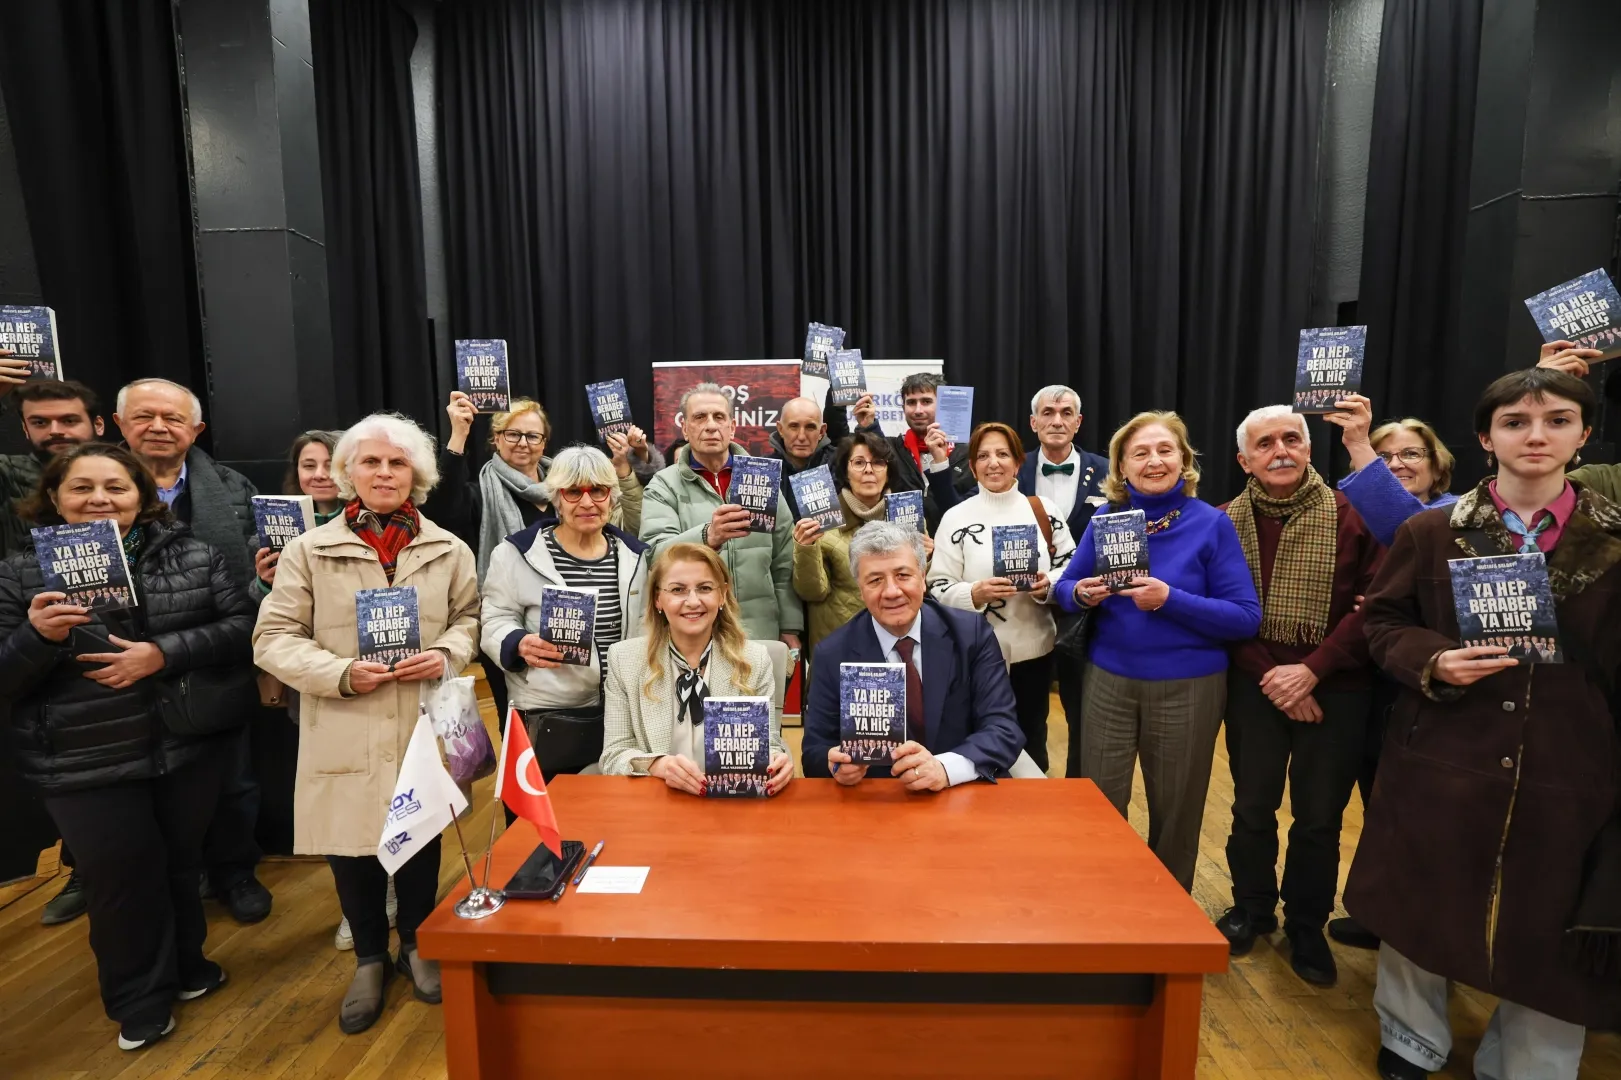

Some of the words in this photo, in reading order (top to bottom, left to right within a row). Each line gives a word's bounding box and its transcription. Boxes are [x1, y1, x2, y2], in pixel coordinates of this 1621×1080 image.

[1548, 302, 1569, 316] YA
[1569, 290, 1596, 309] HEP
[1549, 298, 1610, 328] BERABER
[0, 322, 14, 332] YA
[16, 322, 36, 332] HEP
[1560, 322, 1581, 336] YA
[1581, 312, 1610, 328] HİÇ
[19, 344, 40, 357] HİÇ
[1312, 347, 1326, 358] YA
[1328, 345, 1350, 357] HEP
[467, 356, 478, 366] YA
[480, 356, 495, 366] HEP
[1306, 358, 1353, 370] BERABER
[464, 366, 500, 376] BERABER
[1310, 371, 1323, 382] YA
[1326, 370, 1346, 385] HİÇ
[469, 377, 480, 386] YA
[482, 376, 497, 390] HİÇ
[597, 396, 606, 405] YA
[607, 393, 618, 403] HEP
[721, 385, 749, 404] OŞ
[597, 401, 624, 414] BERABER
[602, 412, 611, 421] YA
[675, 406, 778, 427] İNİZ
[742, 474, 752, 484] YA
[754, 474, 769, 486] HEP
[801, 485, 811, 494] YA
[811, 480, 825, 491] HEP
[738, 484, 772, 497] BERABER
[802, 488, 830, 505] BERABER
[741, 495, 751, 506] YA
[753, 496, 767, 510] HİÇ
[807, 501, 817, 512] YA
[265, 515, 278, 525] YA
[278, 515, 294, 526] HEP
[264, 525, 299, 536] BERABER
[1105, 533, 1117, 544] YA
[1118, 530, 1136, 543] HEP
[270, 536, 282, 545] YA
[1003, 541, 1013, 550] YA
[1014, 539, 1028, 550] HEP
[53, 545, 73, 560] YA
[75, 541, 100, 558] HEP
[1001, 549, 1032, 560] BERABER
[1103, 541, 1140, 555] BERABER
[52, 554, 111, 574] BERABER
[1004, 560, 1014, 569] YA
[1016, 558, 1028, 571] HİÇ
[1108, 555, 1120, 566] YA
[1121, 552, 1137, 566] HİÇ
[62, 571, 82, 586] YA
[82, 568, 108, 584] HİÇ
[1472, 583, 1494, 598] YA
[1496, 580, 1527, 596] HEP
[1469, 595, 1538, 613] BERABER
[370, 608, 384, 619] YA
[386, 606, 404, 618] HEP
[552, 607, 564, 618] YA
[566, 608, 583, 619] HEP
[367, 617, 410, 632] BERABER
[548, 617, 586, 630] BERABER
[1478, 613, 1500, 628] YA
[1502, 611, 1533, 631] HİÇ
[372, 632, 386, 644] YA
[388, 629, 407, 644] HİÇ
[552, 628, 562, 639] YA
[565, 629, 581, 643] HİÇ
[854, 688, 868, 702] YA
[869, 689, 890, 703] HEP
[850, 703, 895, 717] BERABER
[718, 724, 731, 737] YA
[733, 723, 755, 737] HEP
[855, 718, 868, 731] YA
[870, 718, 890, 736] HİÇ
[714, 738, 760, 751] BERABER
[719, 752, 733, 765] YA
[735, 751, 755, 769] HİÇ
